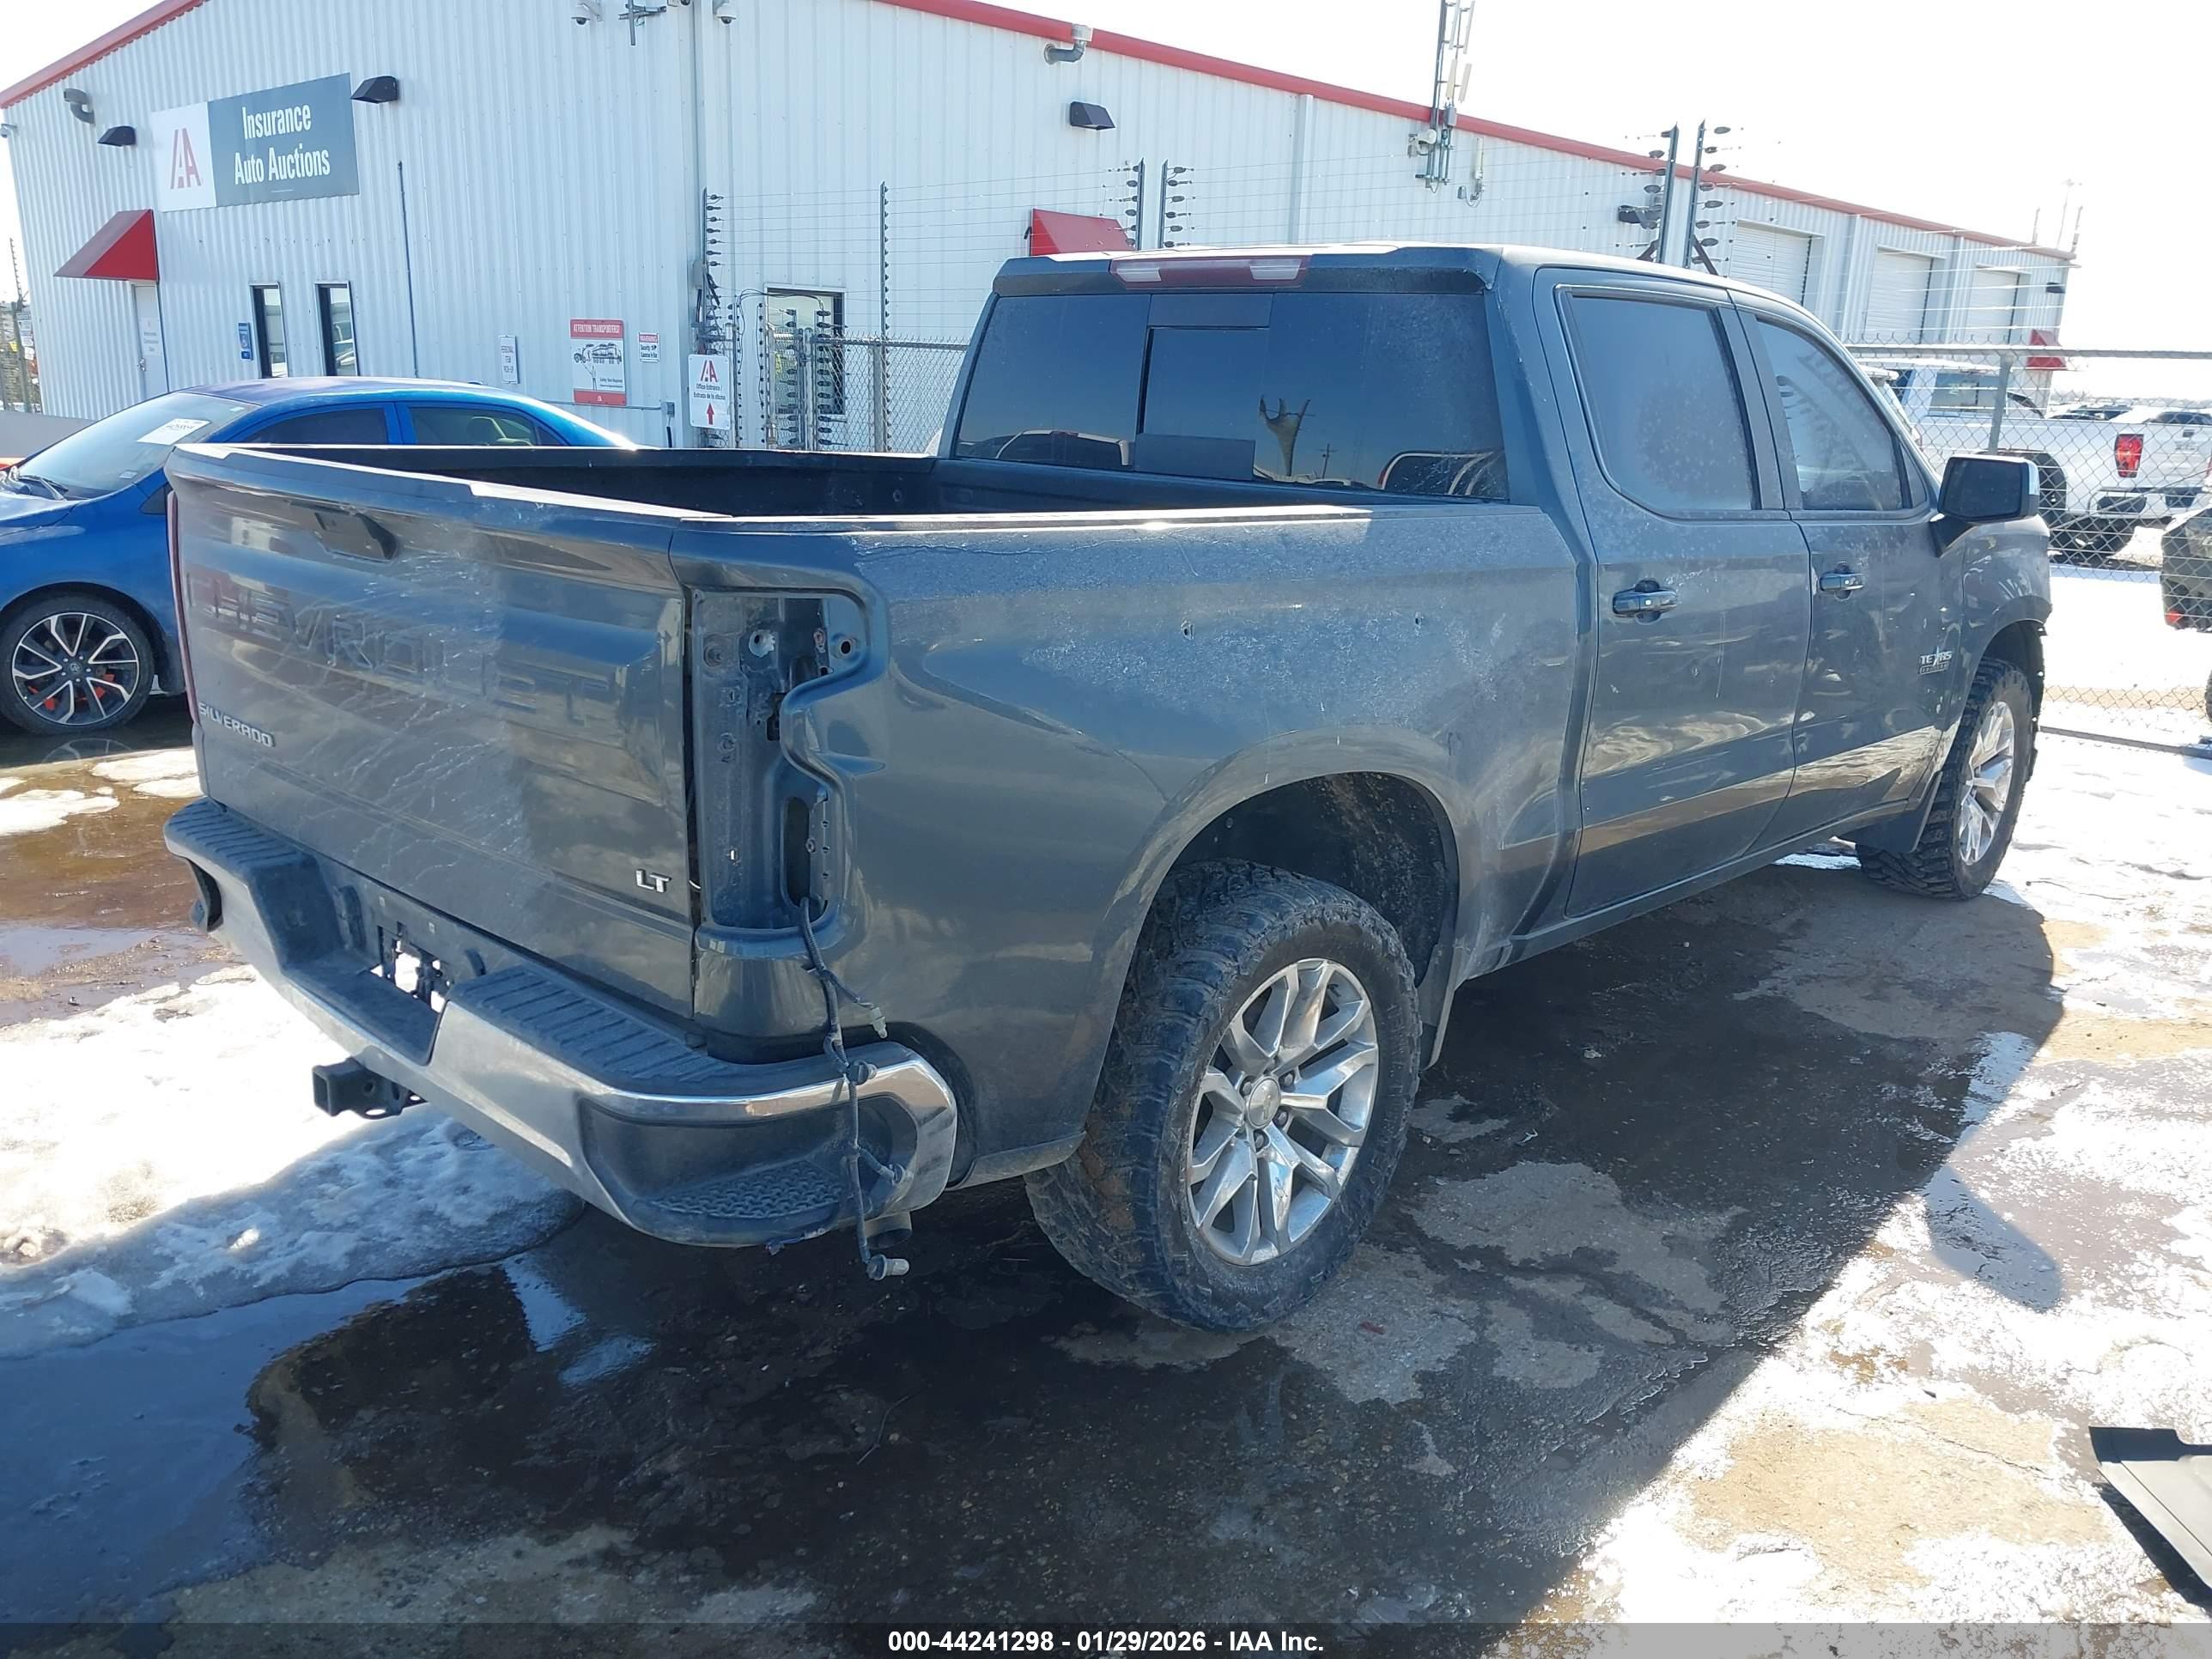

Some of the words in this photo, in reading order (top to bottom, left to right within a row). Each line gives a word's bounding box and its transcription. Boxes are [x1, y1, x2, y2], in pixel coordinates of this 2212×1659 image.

[242, 104, 311, 140] Insurance
[234, 152, 264, 185] Auto
[268, 143, 331, 182] Auctions
[198, 702, 274, 747] SILVERADO
[635, 868, 672, 893] LT
